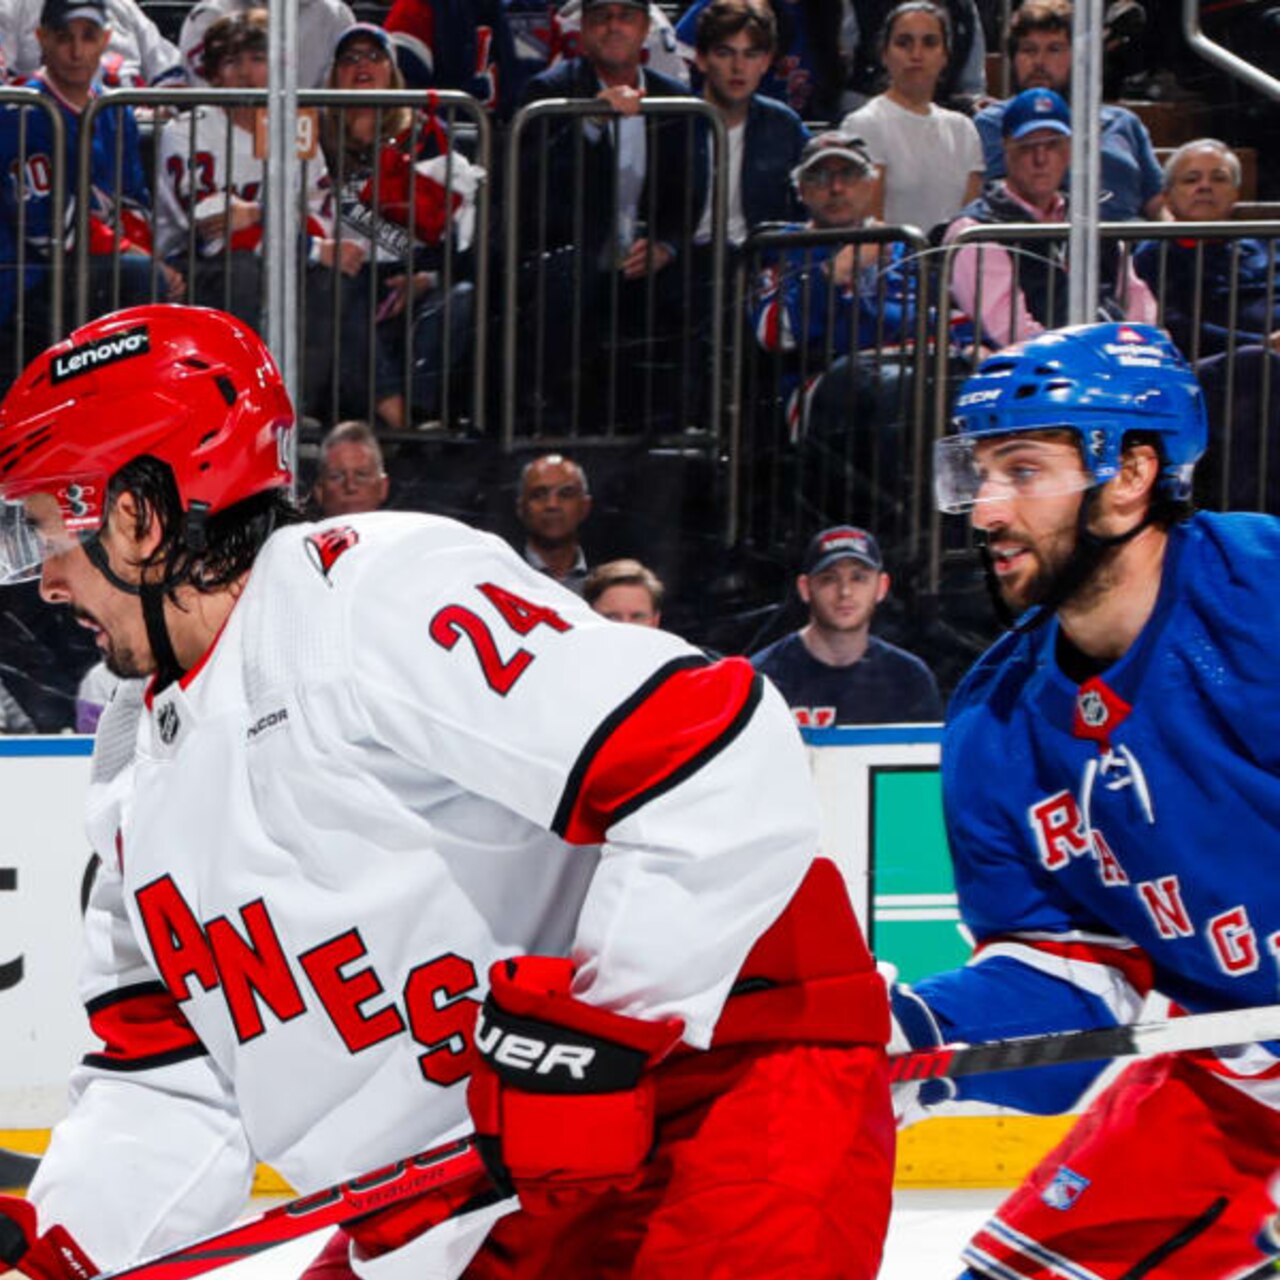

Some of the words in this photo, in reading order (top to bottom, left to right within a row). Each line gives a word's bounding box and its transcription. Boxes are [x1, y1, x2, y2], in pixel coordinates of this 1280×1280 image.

[55, 334, 142, 377] Lenovo
[428, 581, 572, 696] 24
[1028, 788, 1280, 978] RANG
[134, 873, 480, 1088] ANES
